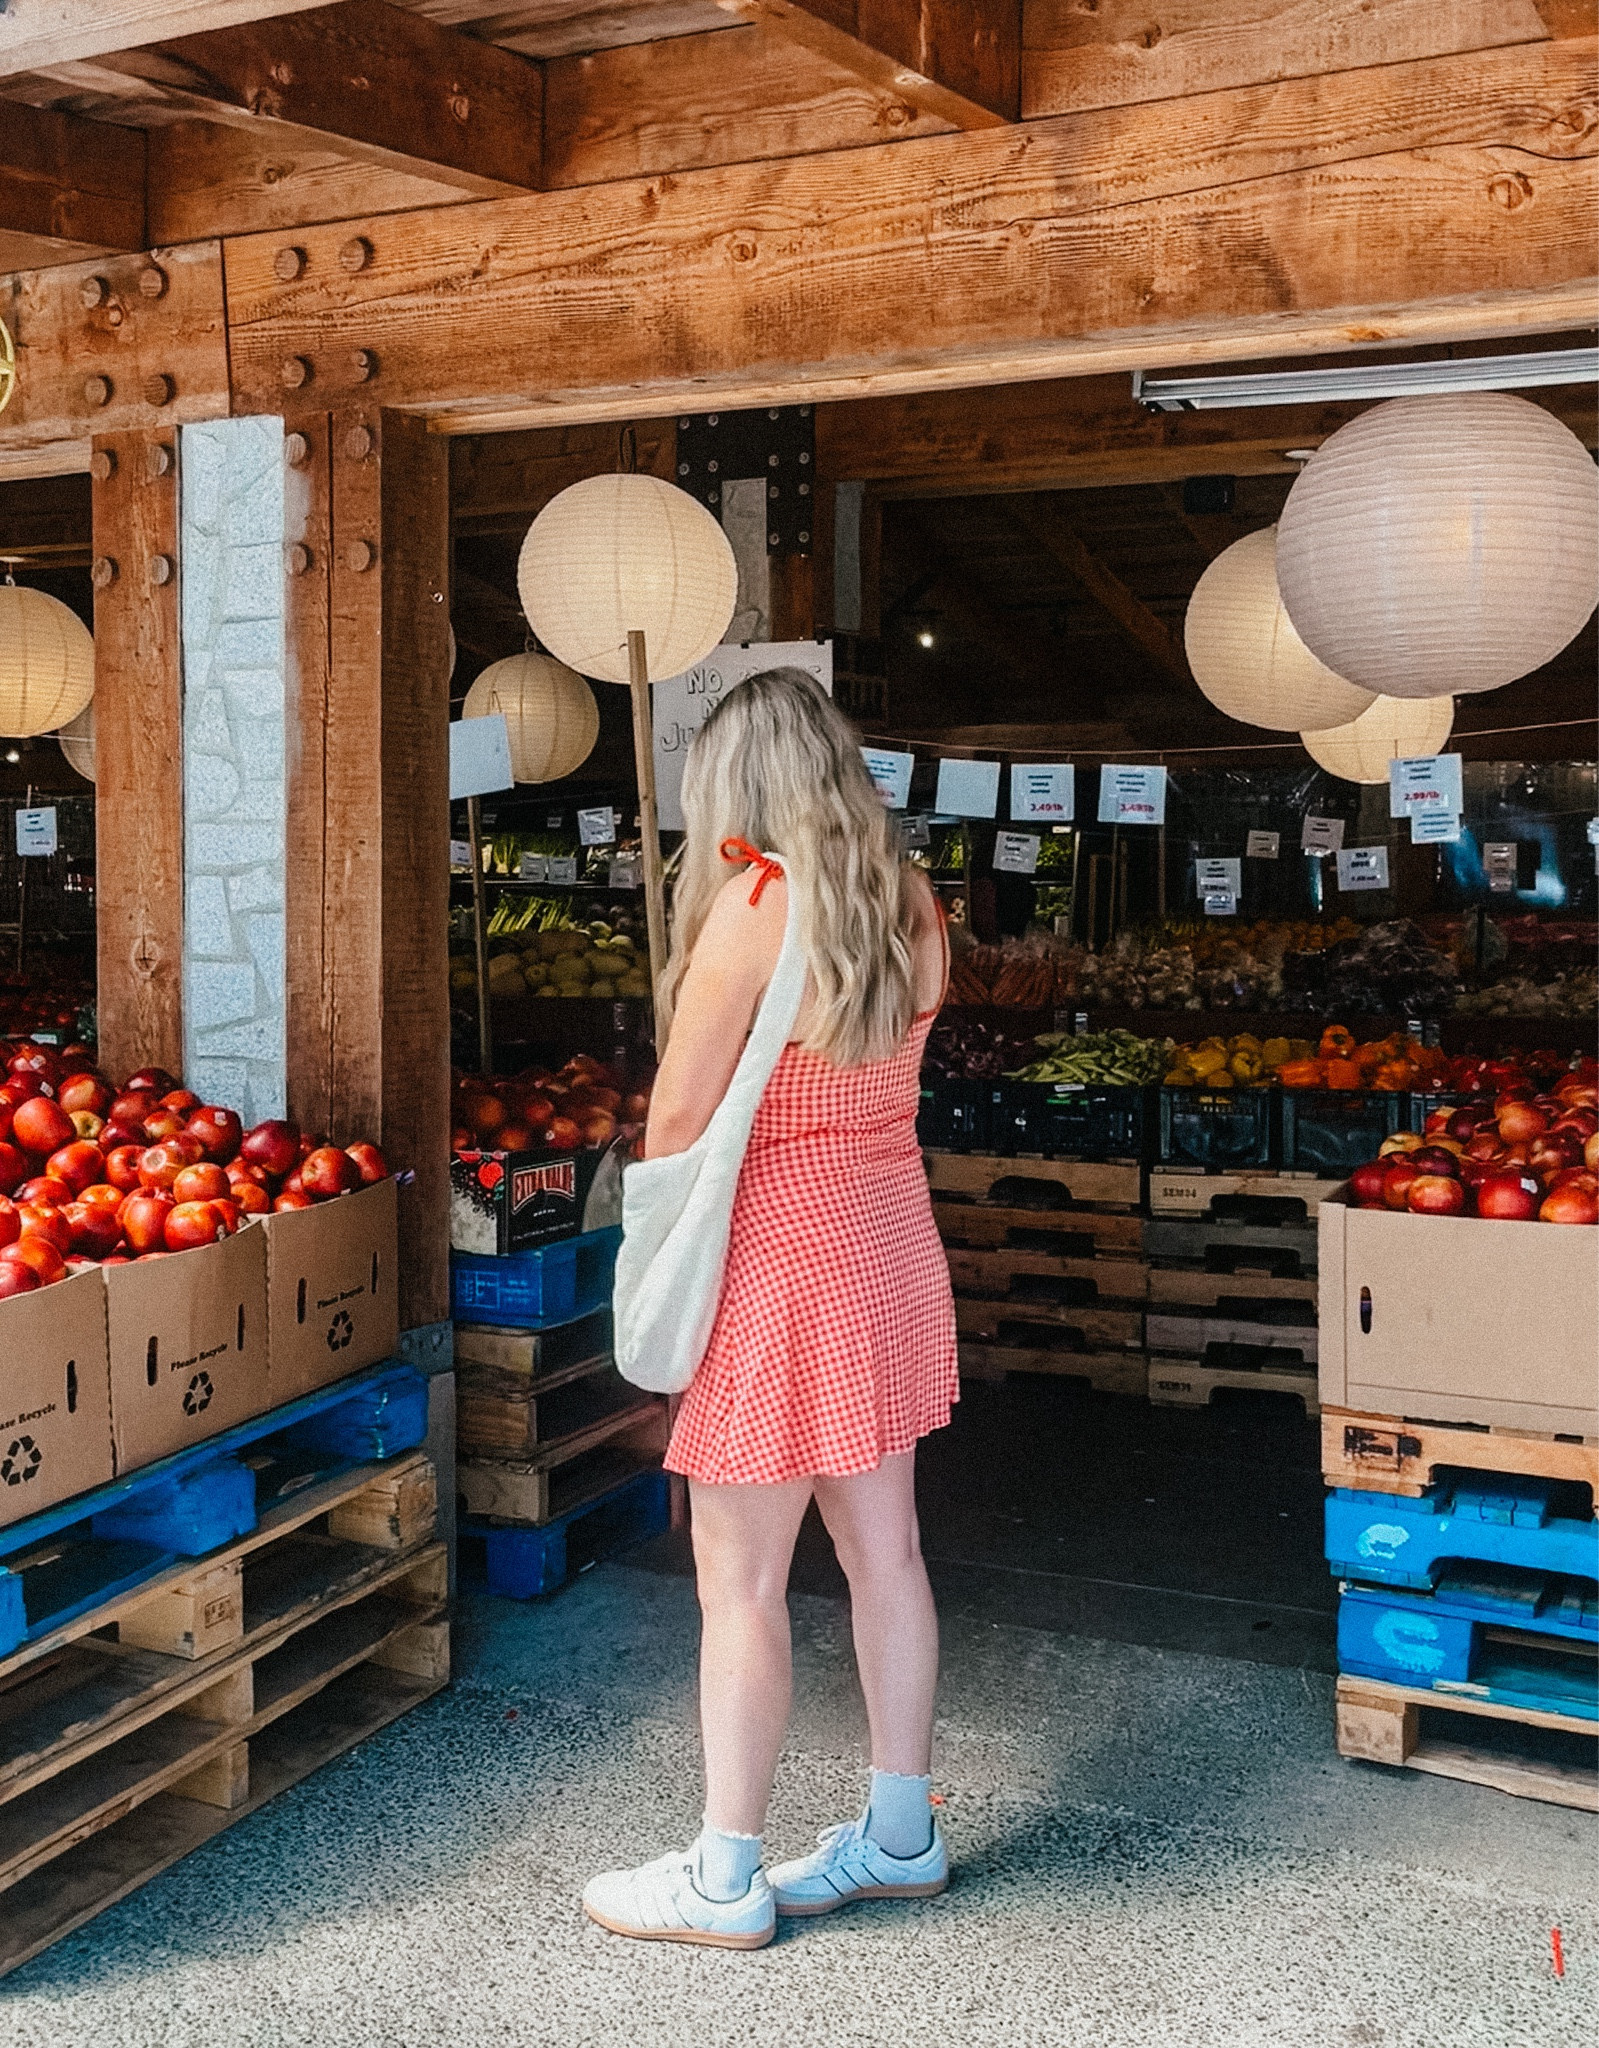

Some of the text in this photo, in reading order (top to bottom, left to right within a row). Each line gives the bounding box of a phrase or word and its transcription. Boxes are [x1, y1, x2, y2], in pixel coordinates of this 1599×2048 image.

[686, 667, 723, 695] NO
[171, 1343, 228, 1372] Please Recycle
[0, 1403, 56, 1430] ase Recycle
